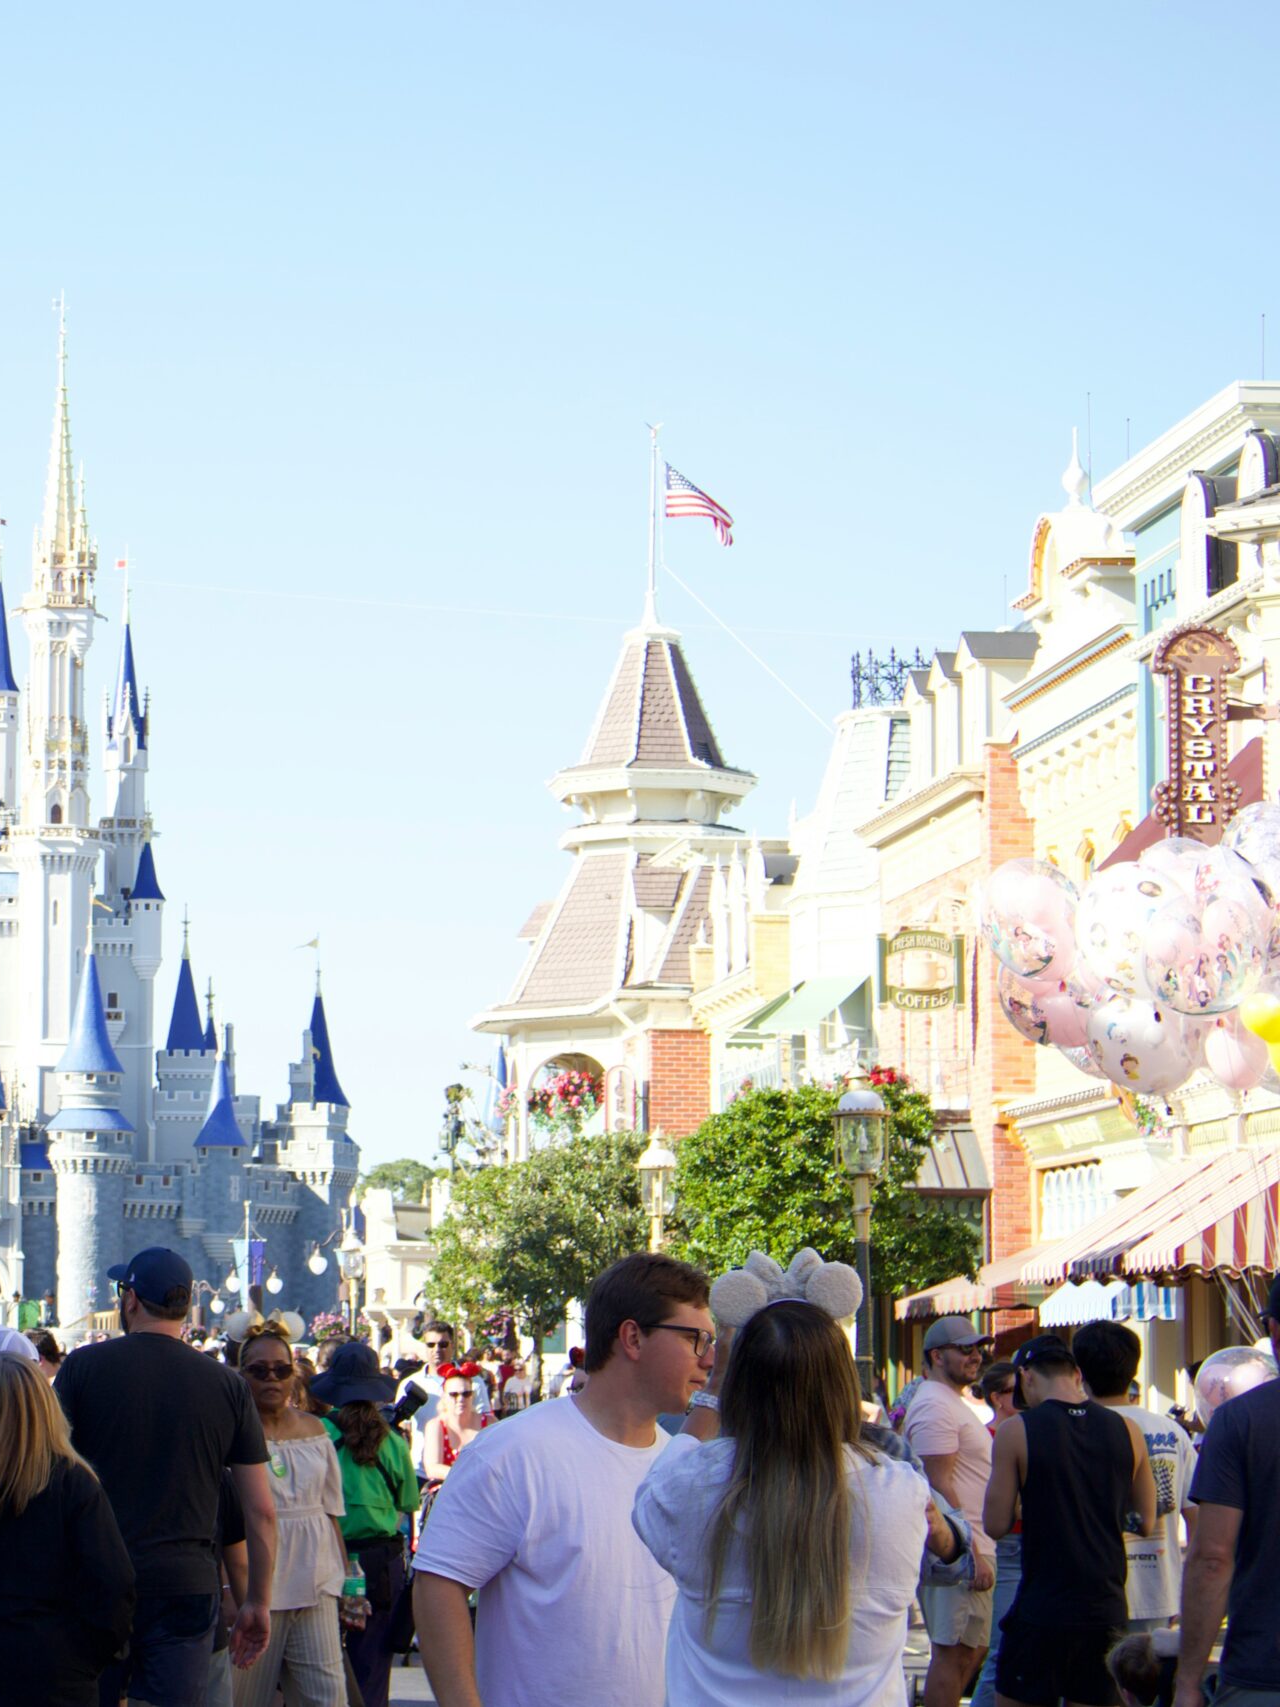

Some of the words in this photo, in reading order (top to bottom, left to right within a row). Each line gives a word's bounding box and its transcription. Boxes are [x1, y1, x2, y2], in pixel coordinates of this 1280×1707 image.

[1182, 674, 1217, 824] CRYSTAL
[893, 934, 916, 952] FRESH
[917, 934, 950, 952] ROASTED
[896, 991, 949, 1009] COFFEE
[1126, 1552, 1157, 1561] aren
